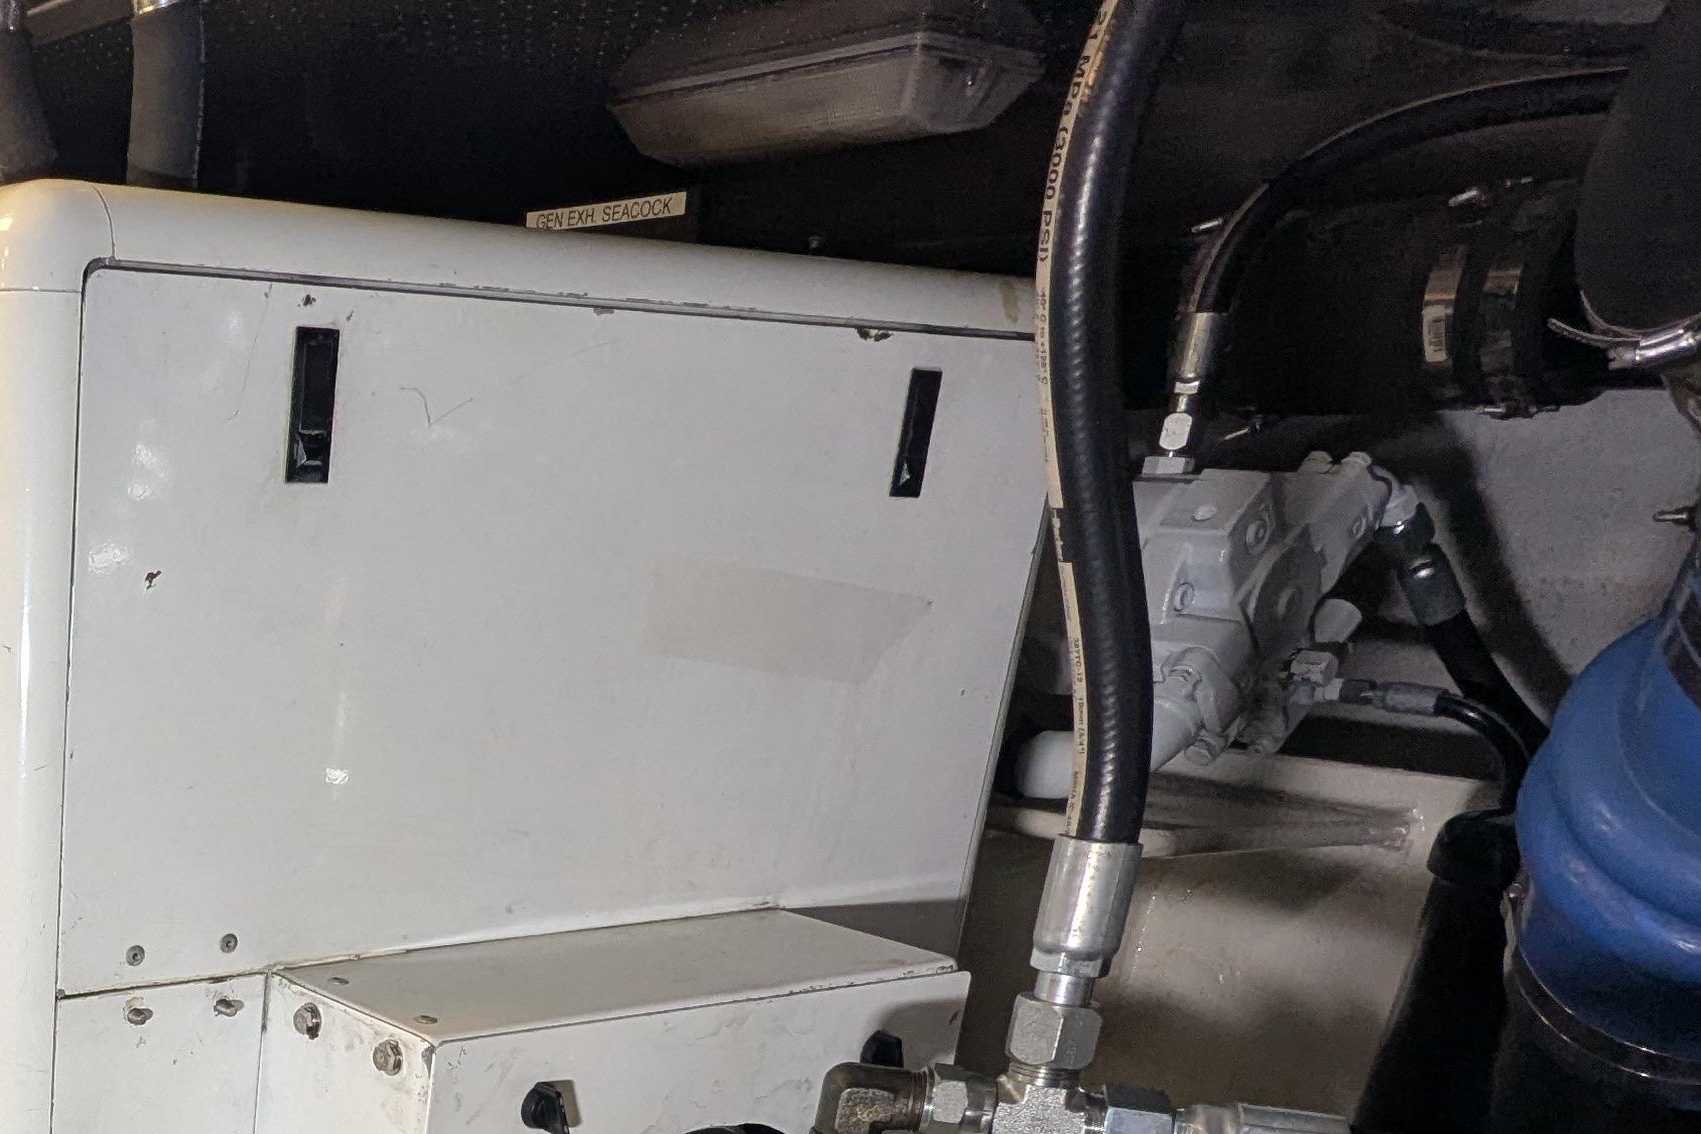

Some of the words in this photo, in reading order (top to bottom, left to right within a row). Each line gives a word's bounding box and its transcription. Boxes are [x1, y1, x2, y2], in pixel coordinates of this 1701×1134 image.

[536, 213, 564, 229] GEN
[568, 208, 597, 226] EXH.
[602, 196, 673, 222] SEACOCK
